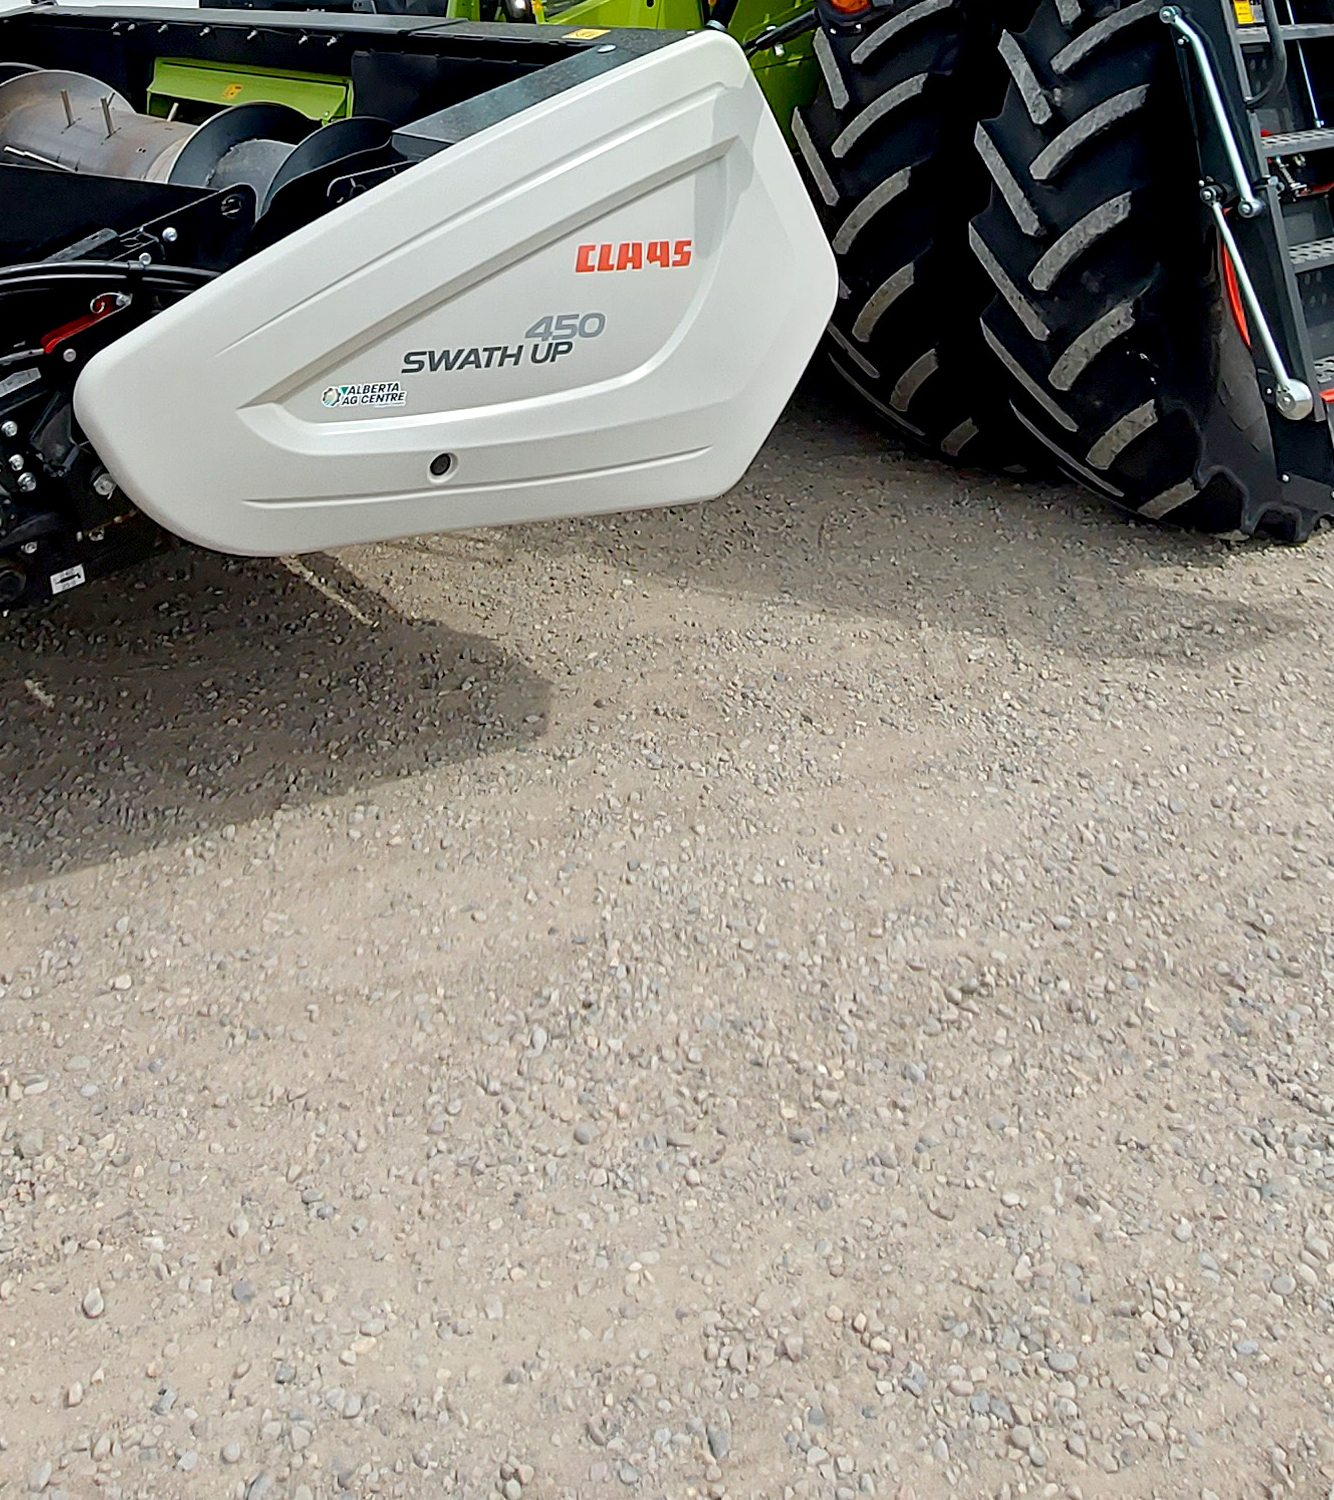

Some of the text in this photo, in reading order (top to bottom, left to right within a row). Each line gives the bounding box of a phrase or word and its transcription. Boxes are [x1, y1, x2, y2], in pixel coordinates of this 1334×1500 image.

[525, 312, 606, 342] 450
[401, 341, 574, 374] SWATH UP
[341, 391, 406, 406] AG CENTRE
[347, 382, 400, 396] ALBERTA
